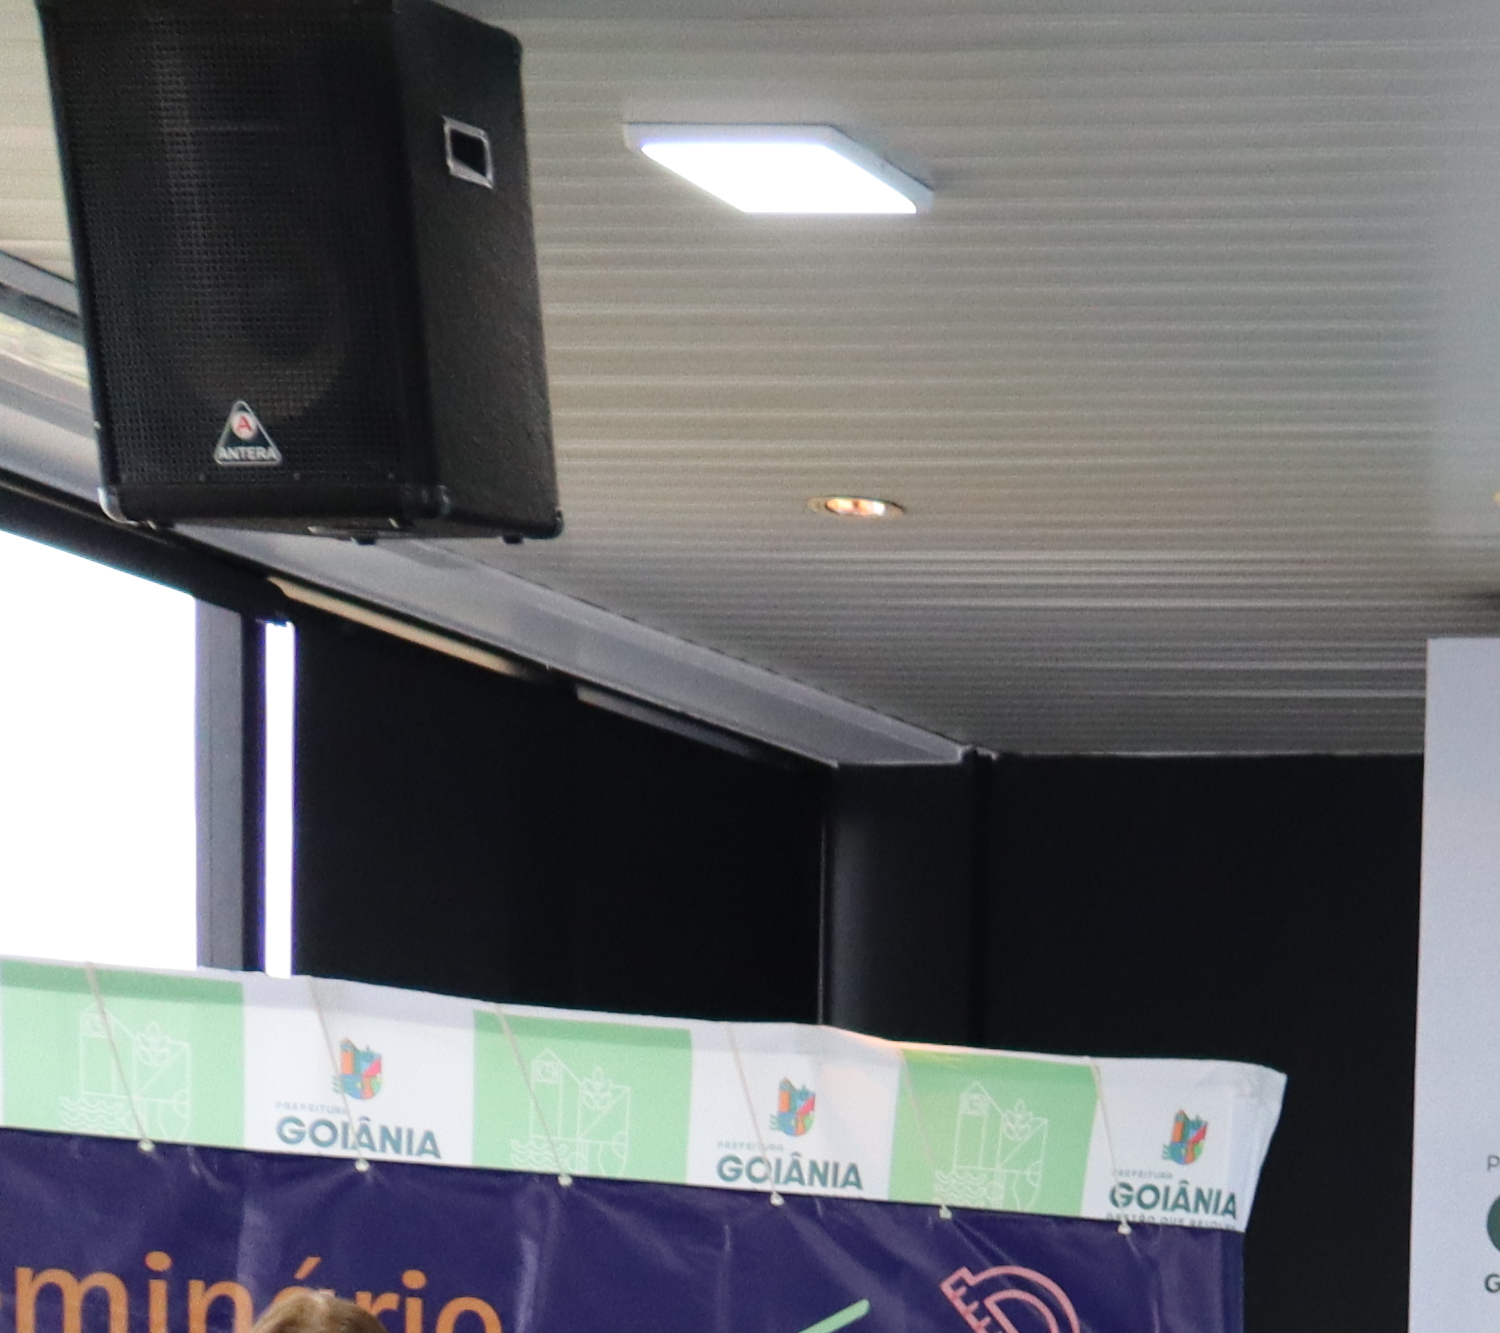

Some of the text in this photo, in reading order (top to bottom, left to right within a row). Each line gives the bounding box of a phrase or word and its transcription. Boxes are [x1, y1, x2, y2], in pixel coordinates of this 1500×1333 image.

[219, 446, 278, 460] ANTERA
[275, 1114, 442, 1160] GOIÂNIA
[715, 1152, 864, 1191] GOIÂNIA
[1109, 1179, 1238, 1220] GOIÂNIA
